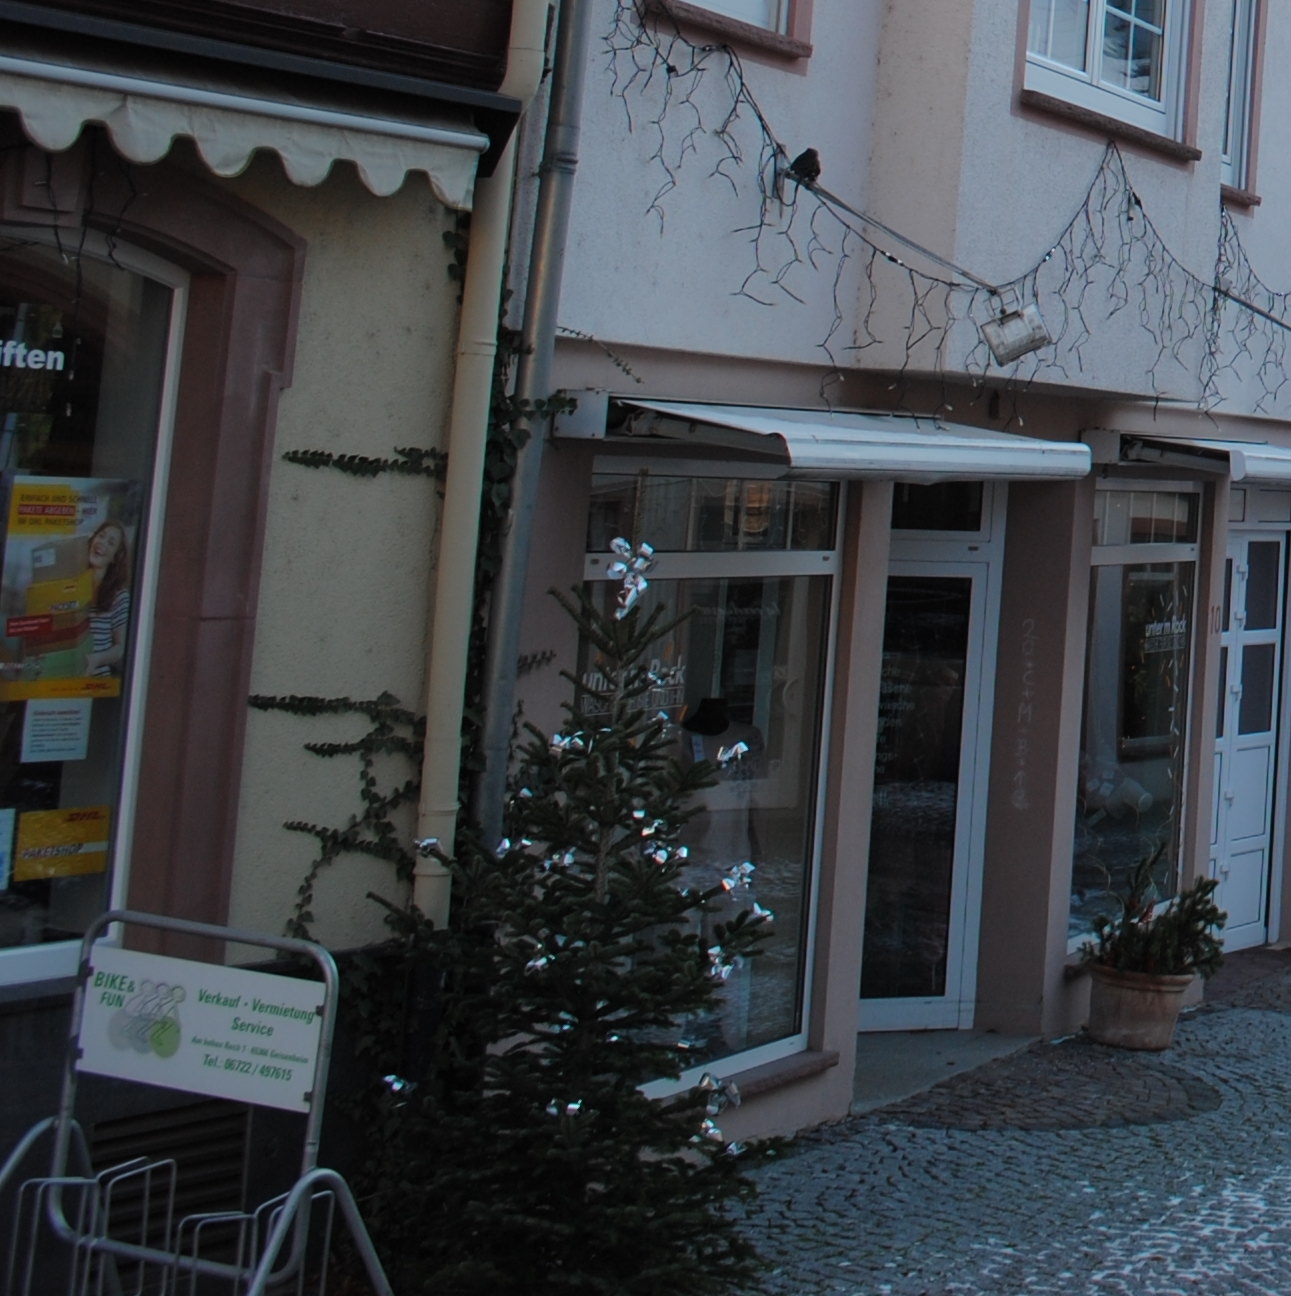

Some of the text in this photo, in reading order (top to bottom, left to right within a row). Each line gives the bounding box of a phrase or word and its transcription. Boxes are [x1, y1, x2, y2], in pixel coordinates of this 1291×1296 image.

[22, 842, 85, 859] PAKETSHOP
[101, 991, 126, 1009] FUN
[197, 988, 317, 1026] Verkauf Vermietung
[231, 1016, 275, 1038] Service
[223, 1057, 253, 1075] 06722
[259, 1064, 294, 1083] 497615
